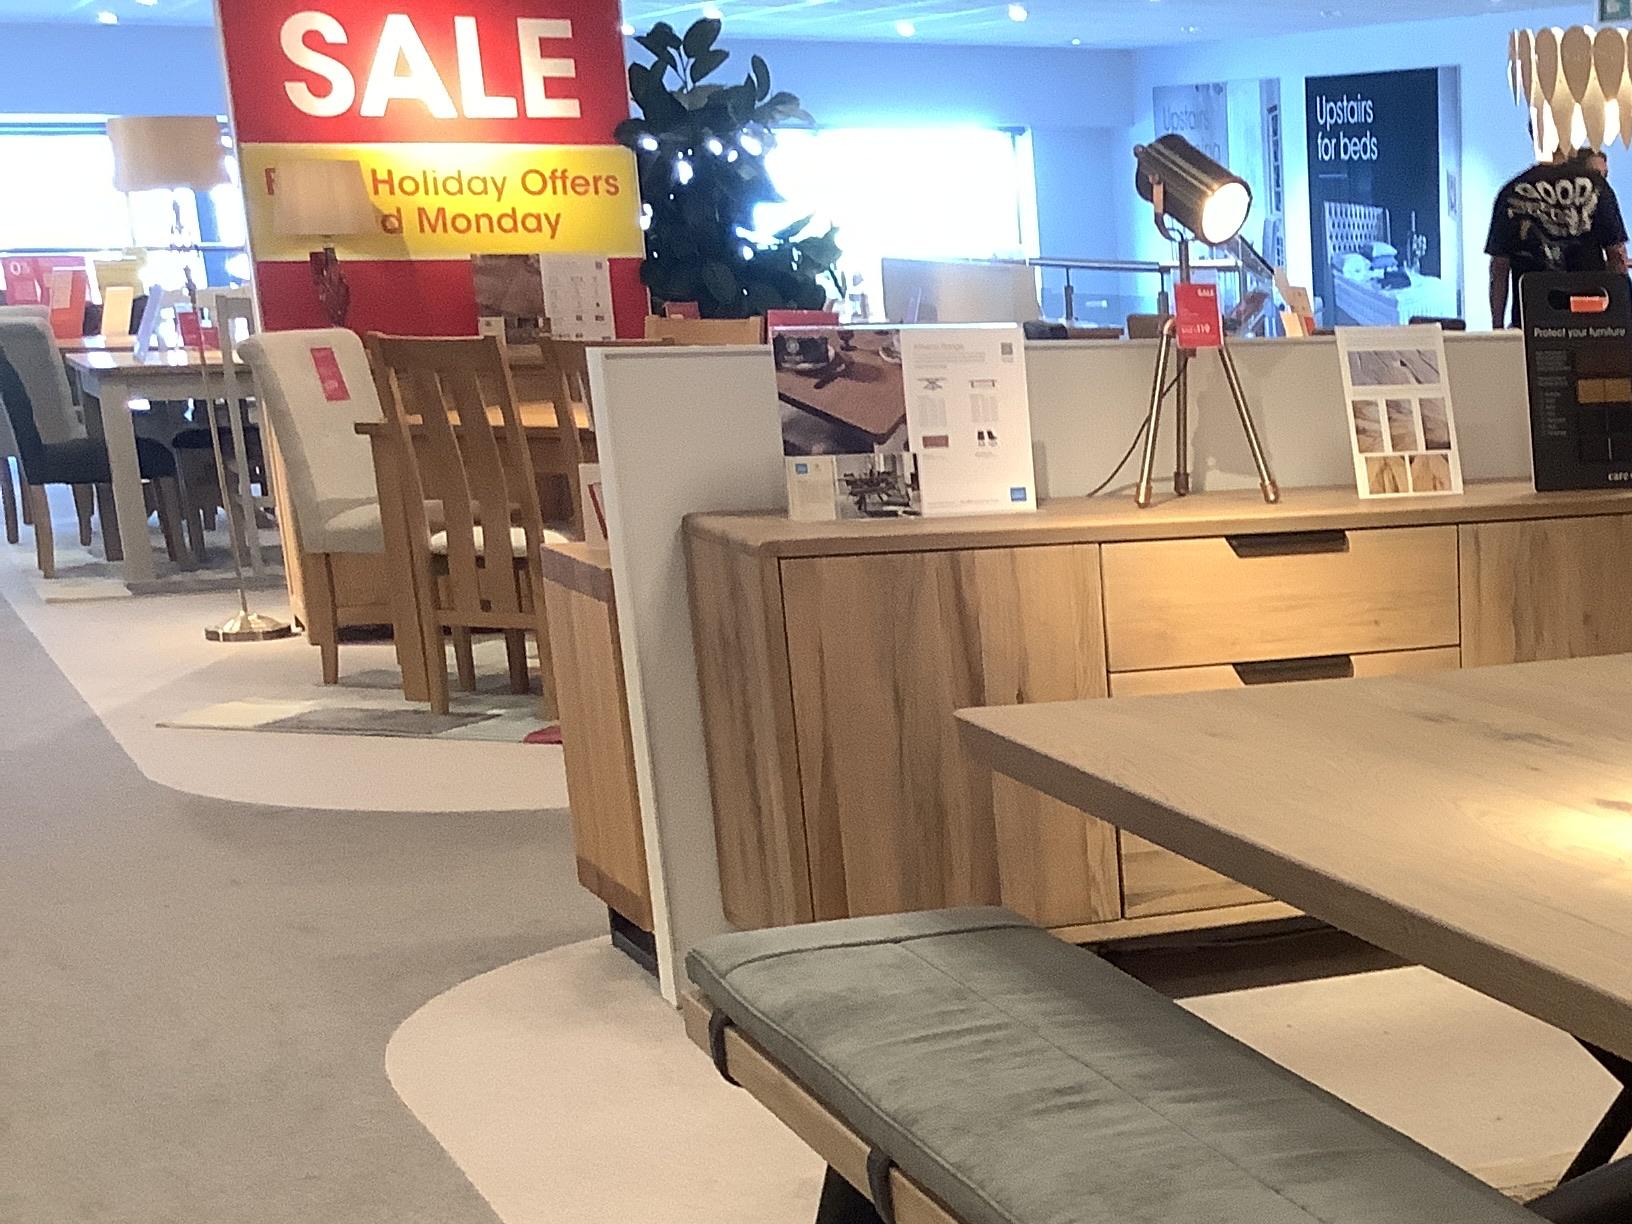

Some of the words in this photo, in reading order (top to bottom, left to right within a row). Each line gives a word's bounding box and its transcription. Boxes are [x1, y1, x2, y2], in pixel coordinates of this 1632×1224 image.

[279, 10, 582, 119] SALE
[1316, 92, 1375, 132] Upstairs
[1317, 131, 1337, 161] for
[1340, 130, 1378, 161] beds
[371, 168, 507, 202] Holiday
[521, 168, 620, 197] Offers
[418, 206, 561, 239] Monday
[1534, 327, 1566, 338] Protect
[1568, 328, 1587, 339] your
[1589, 326, 1625, 338] furniture
